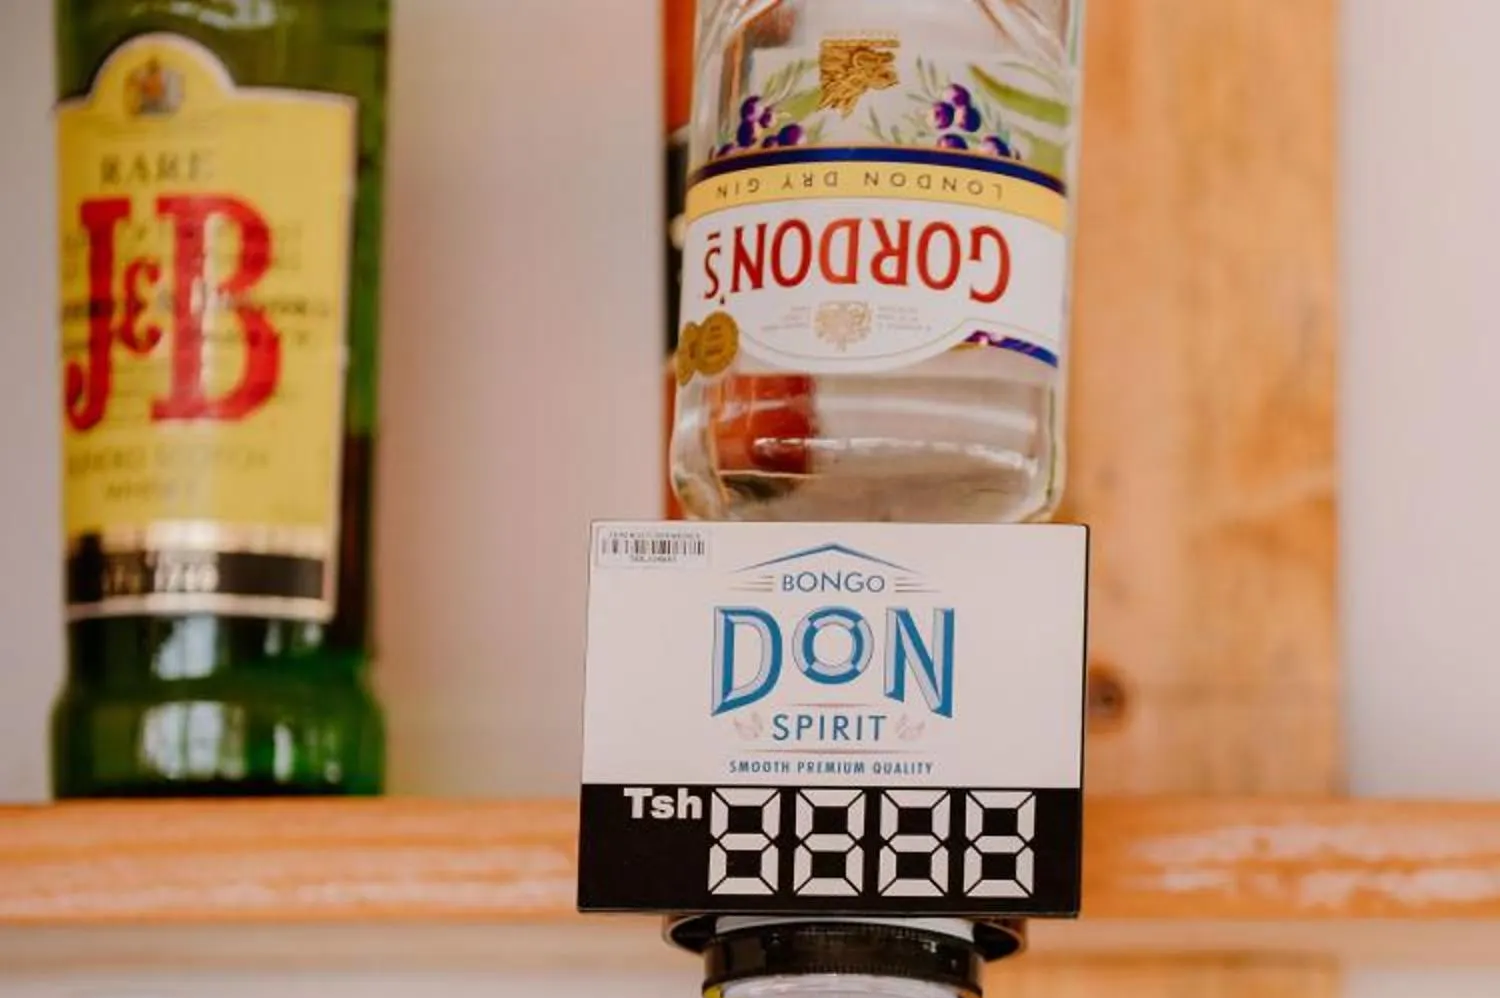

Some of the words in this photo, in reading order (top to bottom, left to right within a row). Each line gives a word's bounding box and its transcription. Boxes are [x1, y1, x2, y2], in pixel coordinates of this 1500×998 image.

[715, 178, 762, 199] GIN
[781, 170, 839, 193] DRY
[863, 172, 1003, 202] LONDON
[703, 217, 1012, 305] GORDON'S
[64, 192, 282, 431] J&B
[781, 570, 887, 594] BONGO
[710, 605, 956, 719] DON
[771, 713, 888, 742] SPIRIT
[728, 759, 791, 774] SMOOTH
[796, 760, 865, 775] PREMIUM
[872, 761, 934, 776] QUALITY
[623, 787, 703, 820] Tsh
